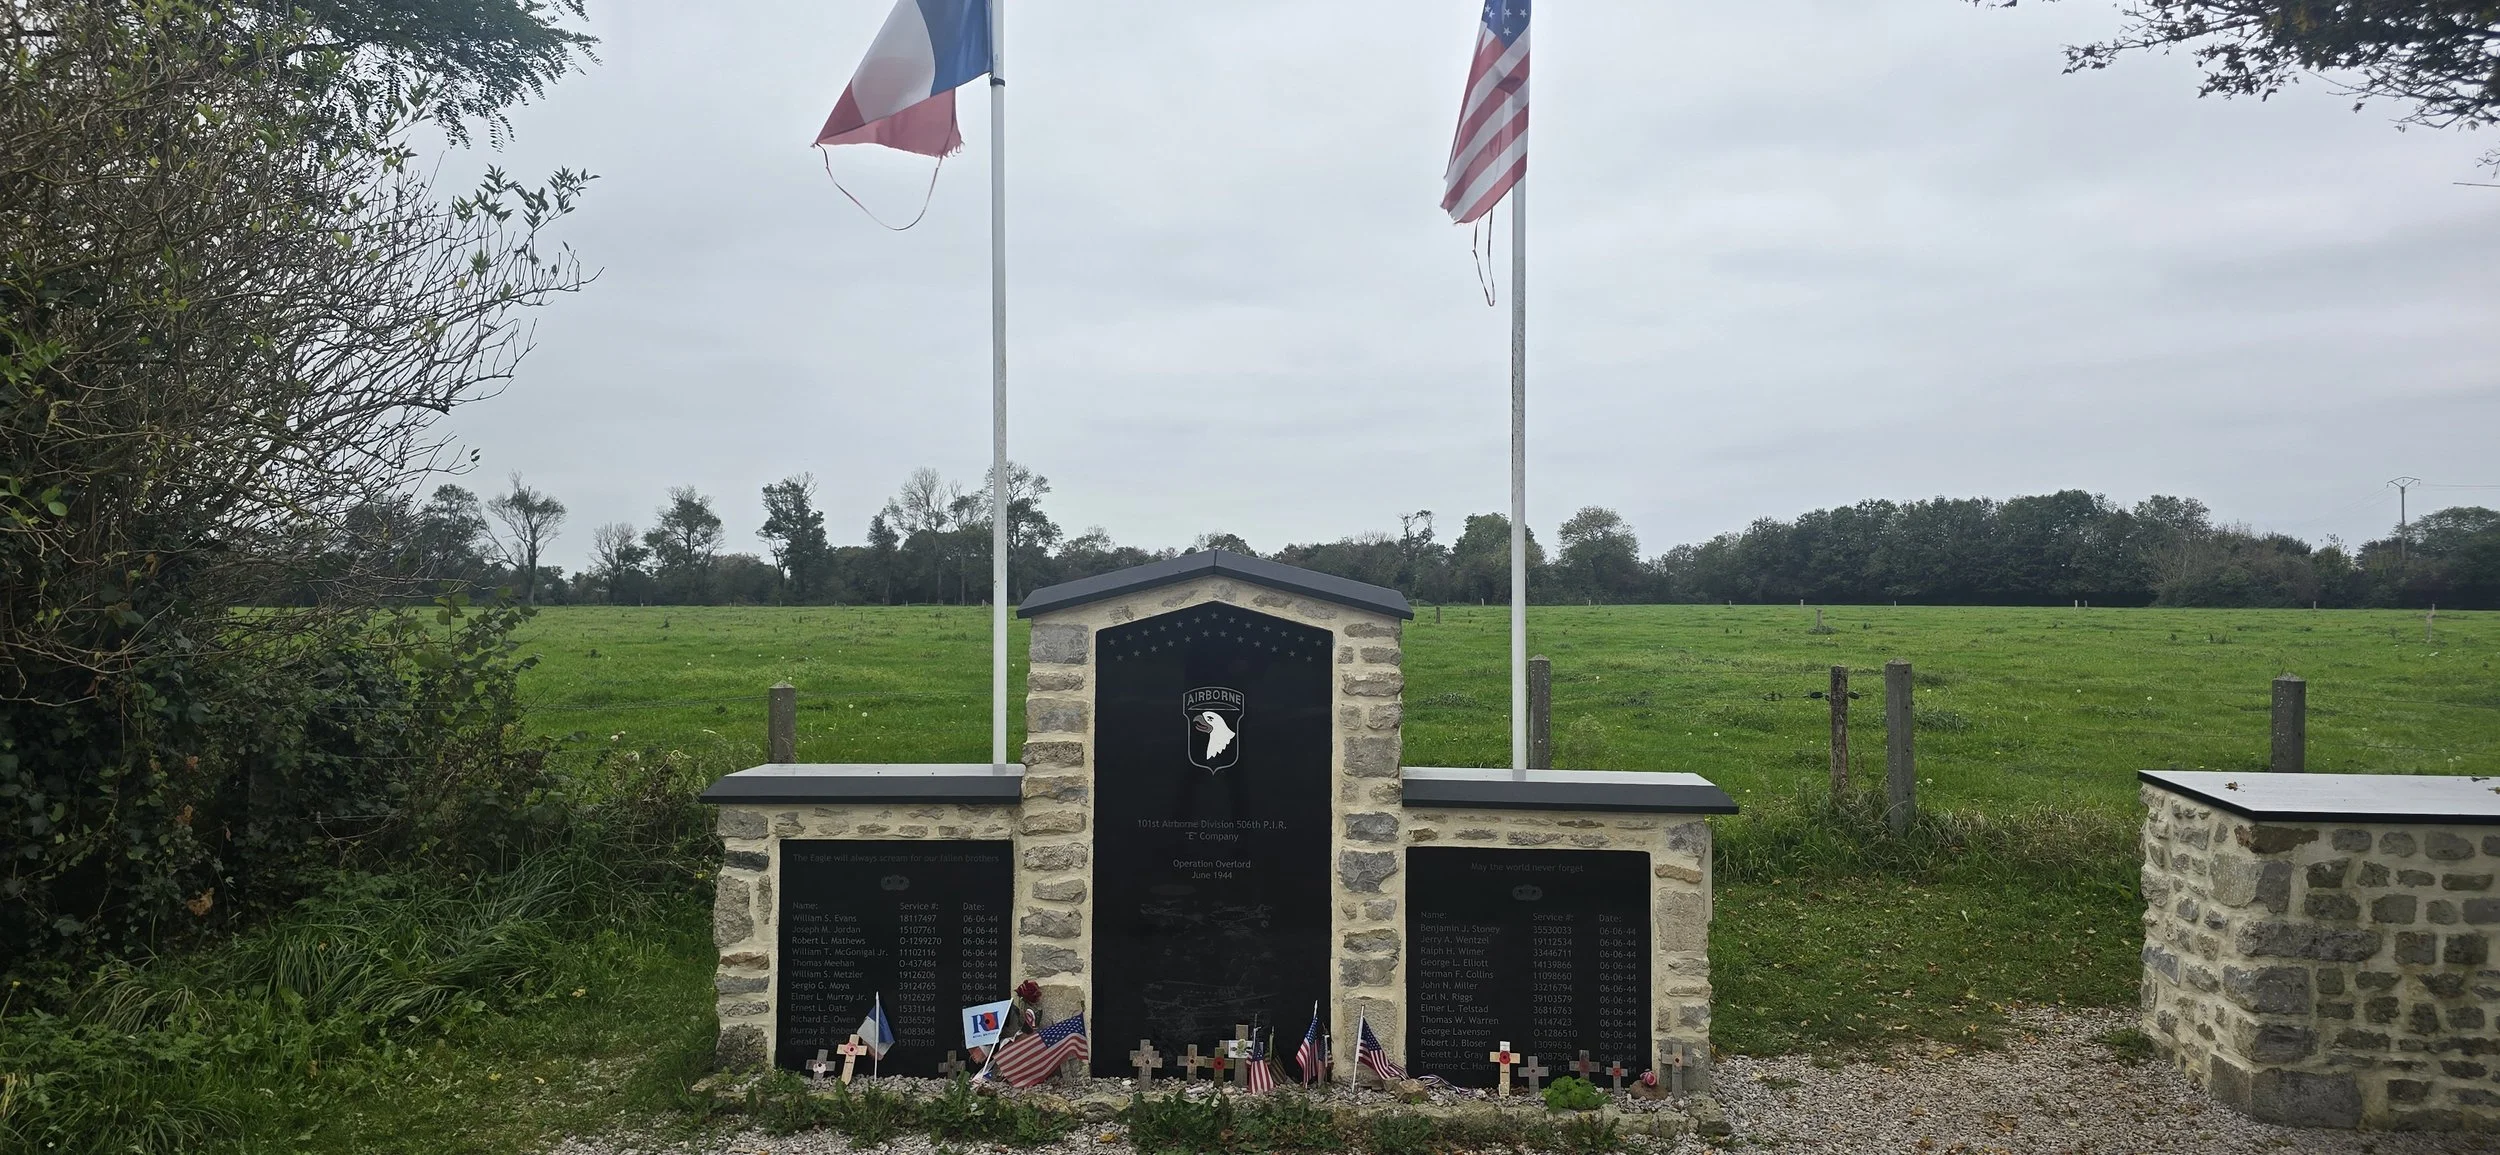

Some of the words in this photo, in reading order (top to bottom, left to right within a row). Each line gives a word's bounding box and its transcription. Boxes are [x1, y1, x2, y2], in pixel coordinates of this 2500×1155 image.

[1187, 690, 1241, 705] AIRBORNE
[1138, 820, 1159, 828] 101st
[1162, 820, 1198, 828] Airborne
[1201, 820, 1234, 828] Division
[1237, 820, 1260, 829] 506th
[1264, 820, 1286, 829] P.I.R.
[1200, 832, 1238, 842] Company
[811, 854, 832, 863] Eagle
[851, 854, 877, 863] always
[1173, 860, 1213, 870] Operation
[1472, 862, 1487, 872] May
[1559, 864, 1583, 873] forget
[1533, 913, 1563, 921] Service
[1599, 914, 1621, 922] Date:
[793, 926, 819, 935] Joseph
[1421, 924, 1460, 935] Benjamin
[1472, 925, 1500, 935] Stoney
[1600, 927, 1635, 935] 06-06-44
[1421, 936, 1442, 946] Jerry
[1456, 936, 1489, 944] Wentzel
[824, 948, 832, 956] T.
[835, 948, 875, 958] McGonigal
[1421, 947, 1444, 958] Ralph
[1600, 950, 1636, 959] 06-06-44
[963, 960, 997, 968] 06-06-44
[1421, 959, 1450, 969] George
[1600, 973, 1636, 982] 06-06-44
[792, 982, 816, 991] Sergio
[830, 982, 850, 991] Moya
[1421, 982, 1440, 990] John
[1600, 985, 1636, 993] 06-06-44
[827, 994, 854, 1002] Murray
[1421, 993, 1437, 1001] Carl
[1452, 993, 1472, 1003] Riggs
[1600, 1007, 1636, 1016] 06-06-44
[791, 1026, 817, 1036] Murray
[1421, 1027, 1450, 1038] George
[1600, 1031, 1636, 1039] 06-06-44
[1421, 1050, 1451, 1058] Everett
[1464, 1051, 1483, 1061] Gray
[1533, 1053, 1573, 1061] 9087506
[1421, 1062, 1458, 1070] Terrence
